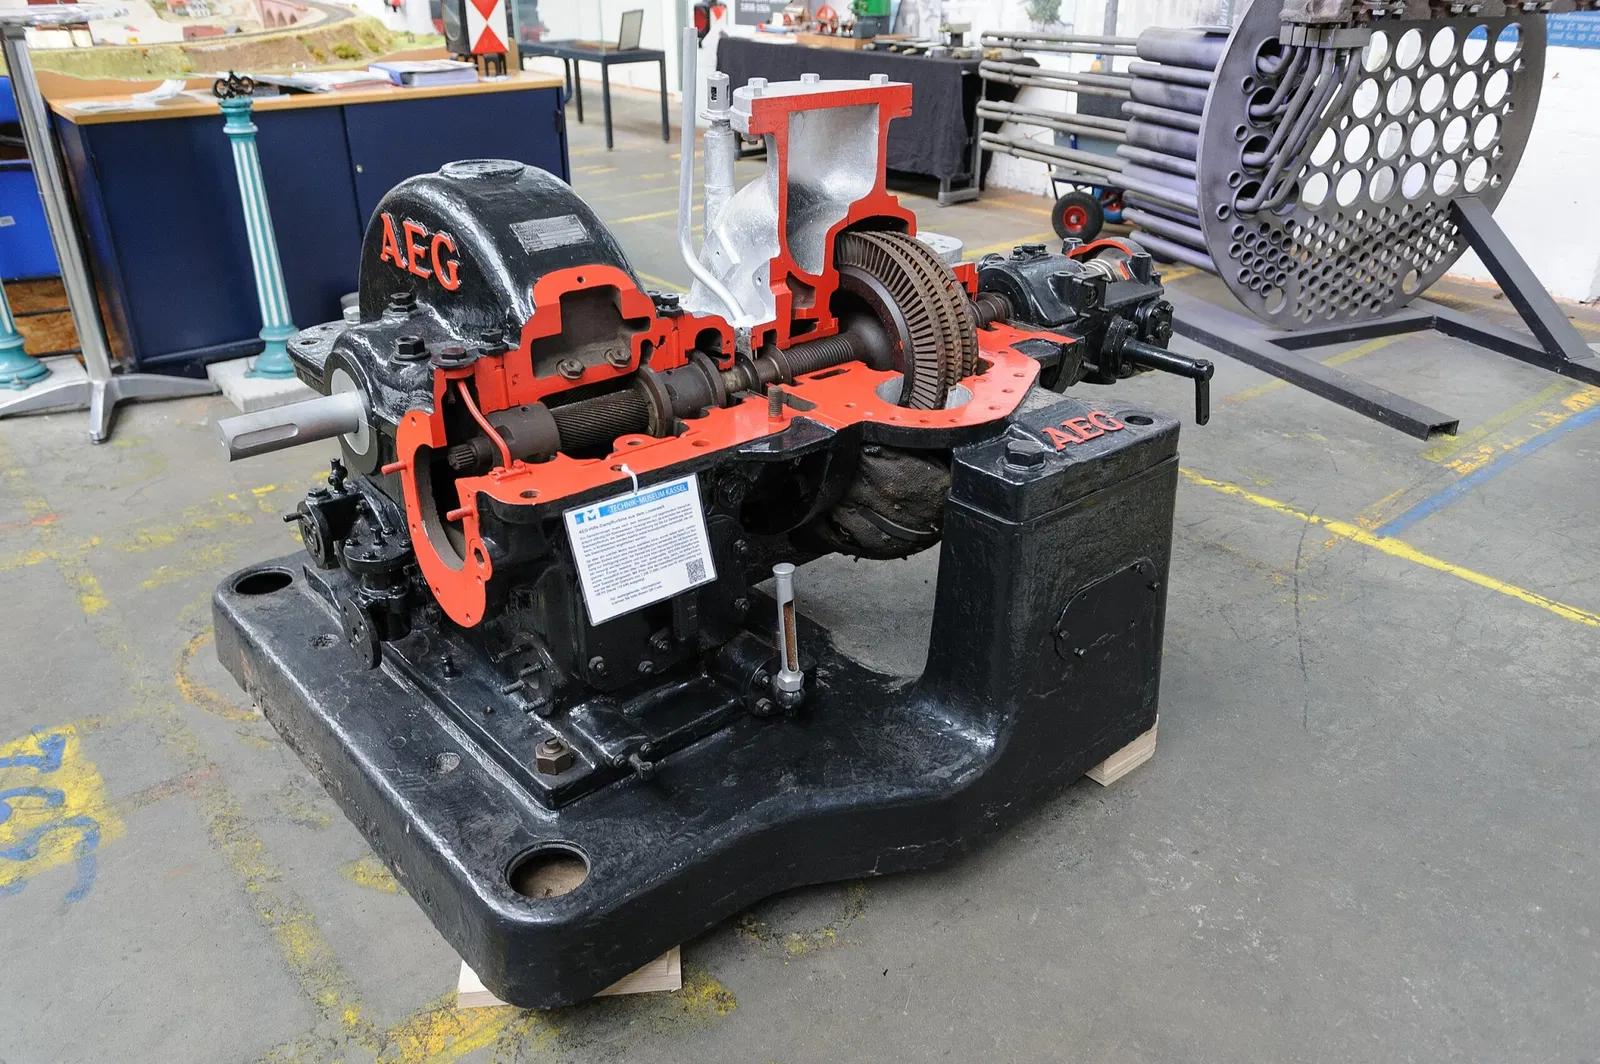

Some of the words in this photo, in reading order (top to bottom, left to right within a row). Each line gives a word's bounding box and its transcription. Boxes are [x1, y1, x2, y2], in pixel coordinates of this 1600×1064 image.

[380, 212, 461, 290] AEG
[1042, 410, 1125, 452] AEG
[666, 484, 687, 497] KASSEL
